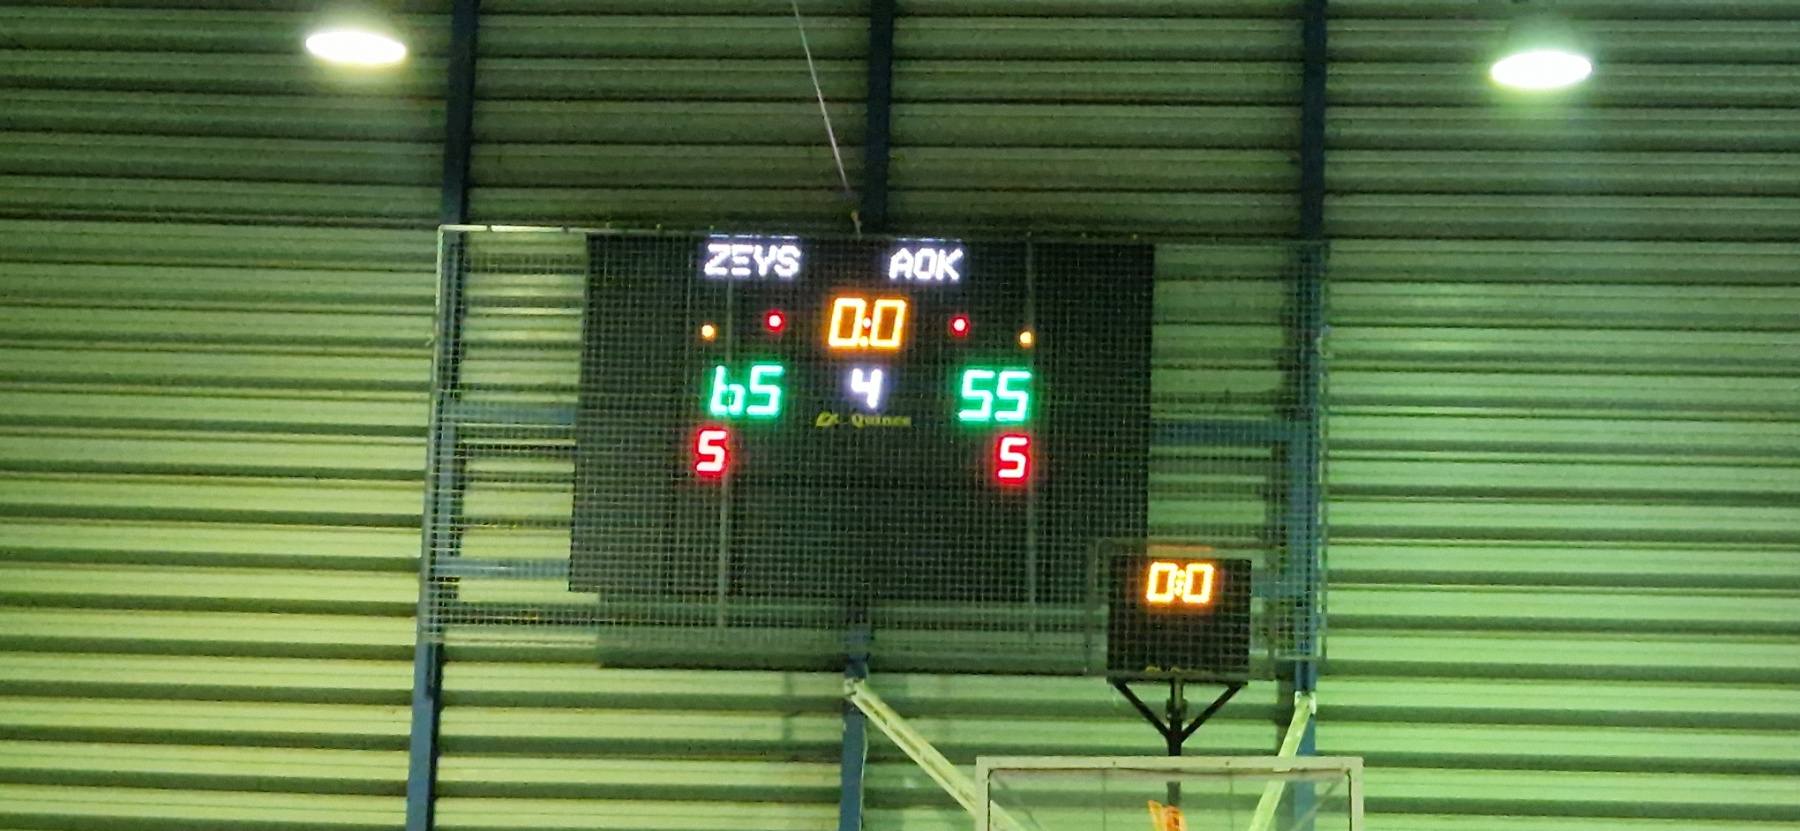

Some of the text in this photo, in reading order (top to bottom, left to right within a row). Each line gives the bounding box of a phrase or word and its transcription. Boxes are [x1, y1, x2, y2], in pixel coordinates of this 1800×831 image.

[704, 243, 801, 278] ZEYS
[889, 247, 963, 281] AOK
[849, 368, 884, 409] 4
[957, 369, 1033, 422] 55
[695, 429, 729, 476] 5
[996, 436, 1030, 483] 5
